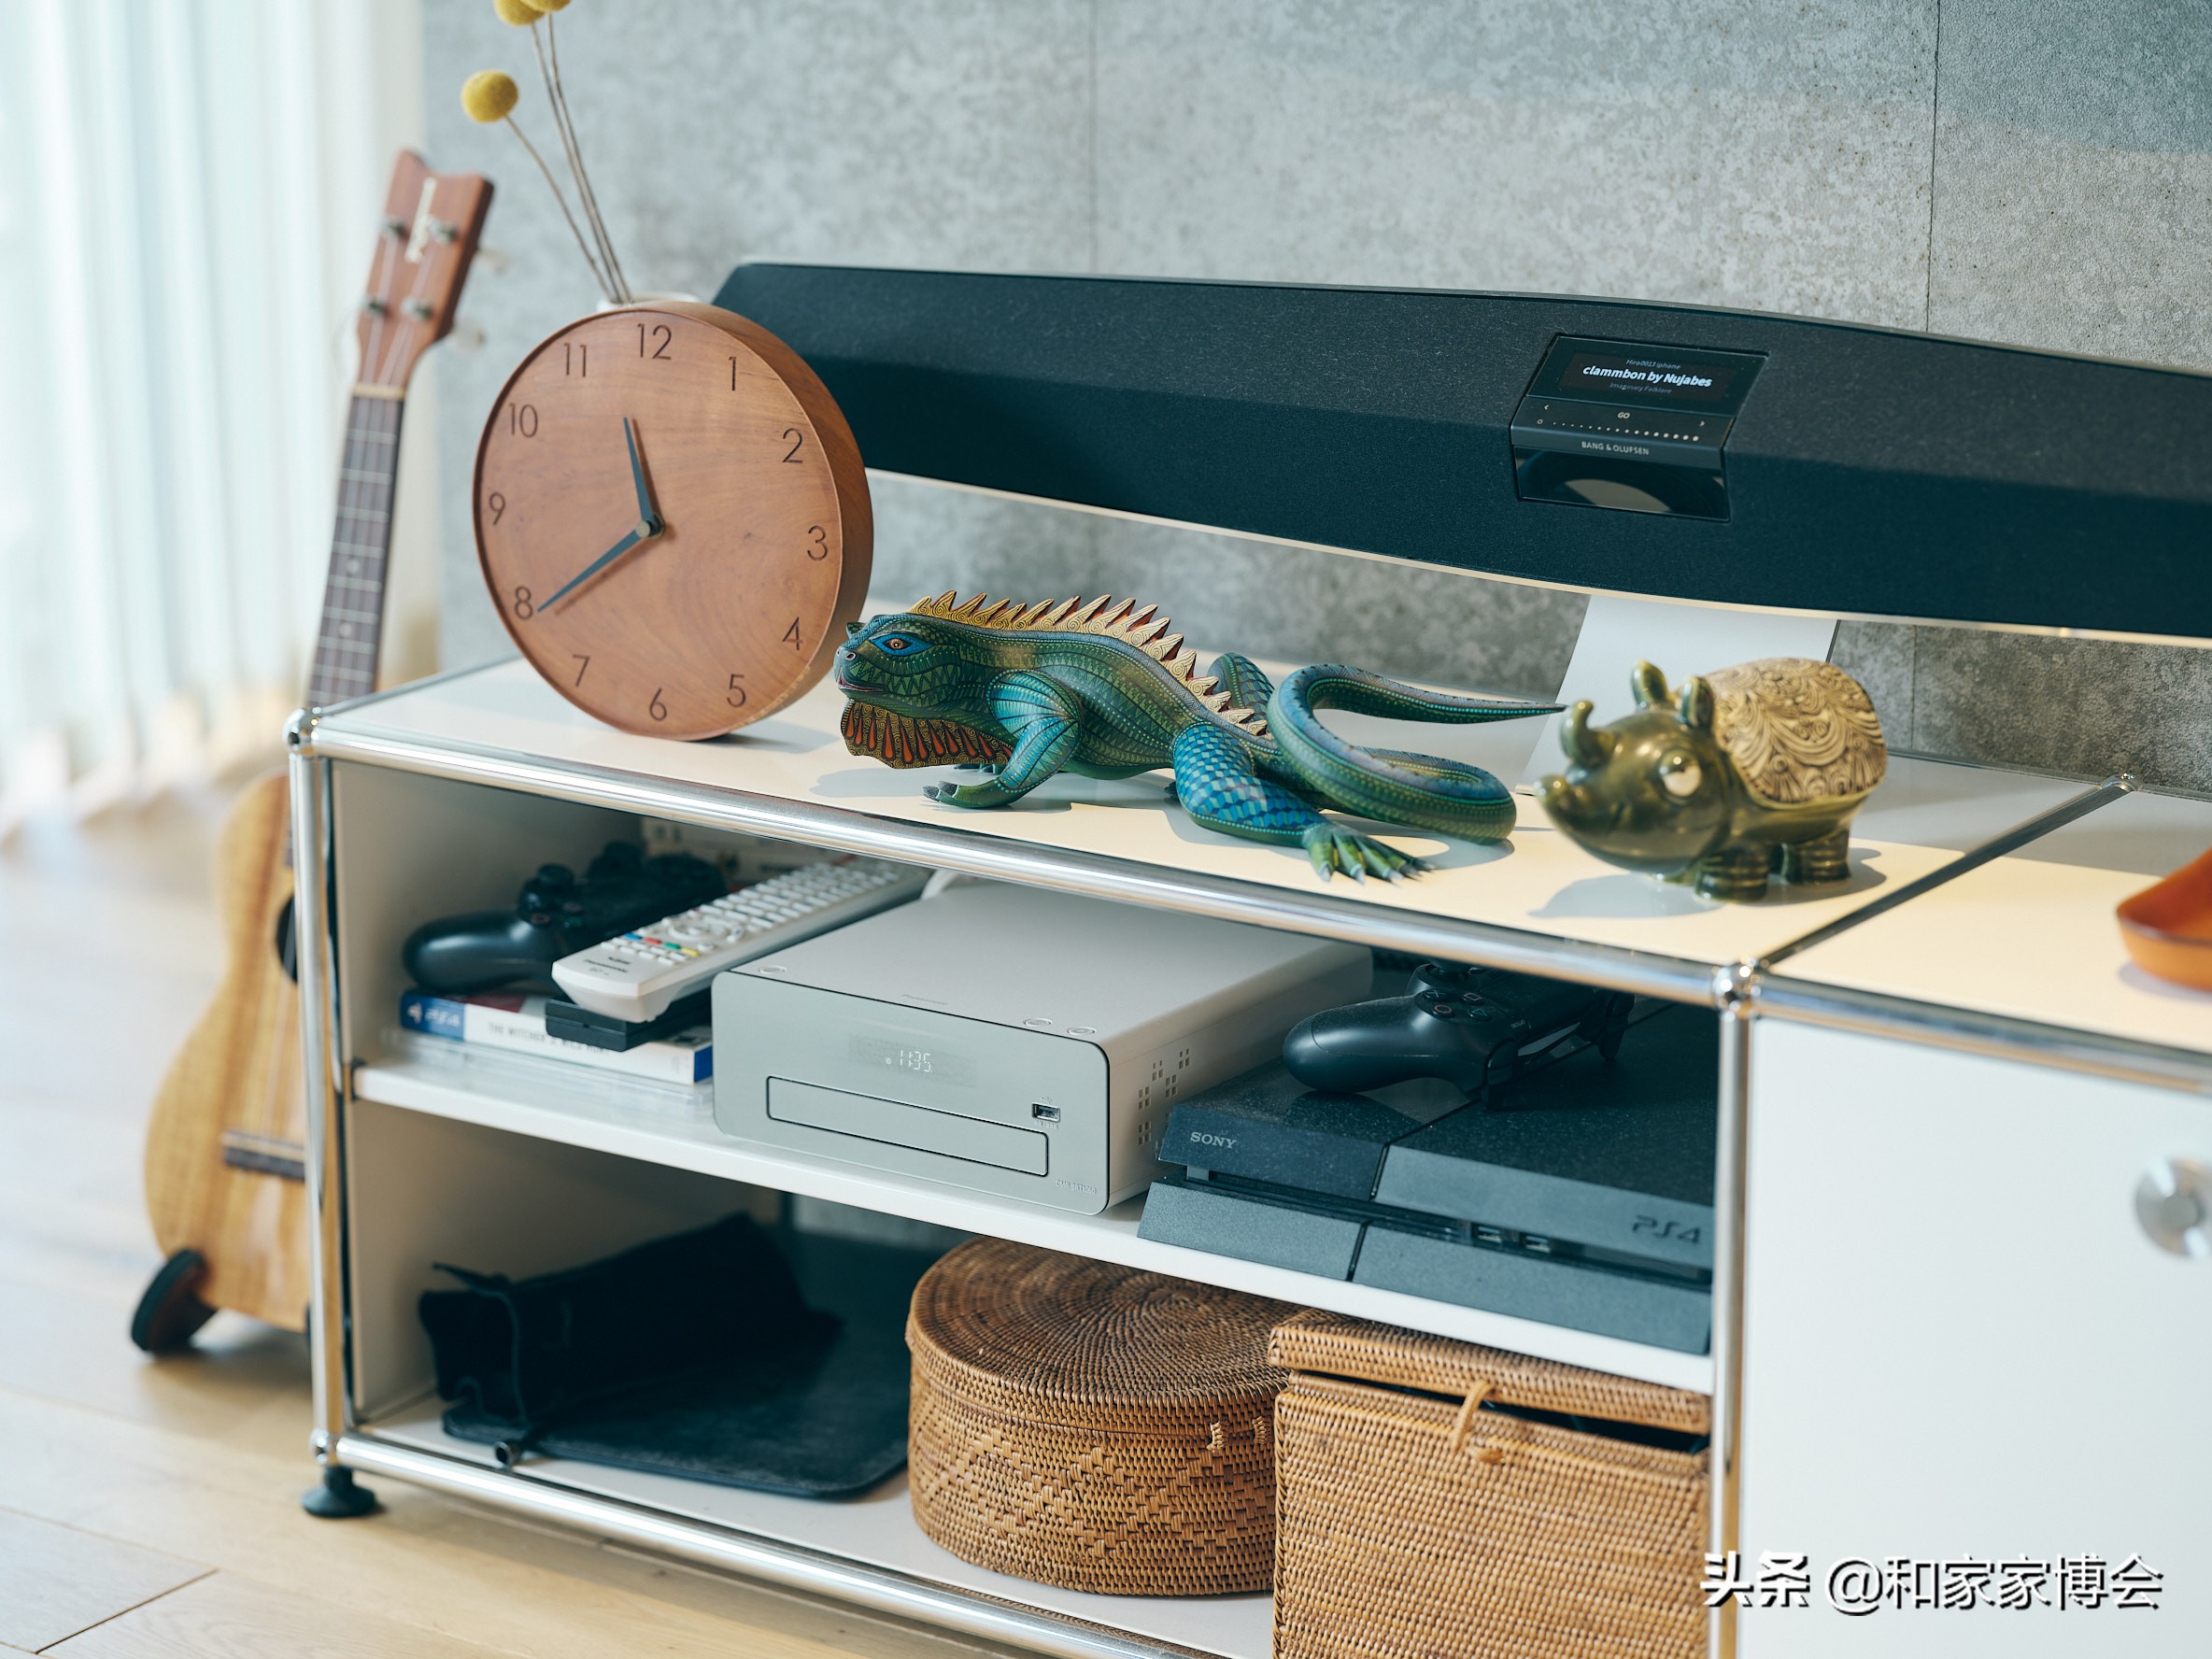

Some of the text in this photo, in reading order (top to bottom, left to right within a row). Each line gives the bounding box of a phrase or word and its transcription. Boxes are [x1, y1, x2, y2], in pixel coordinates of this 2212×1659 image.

[637, 323, 672, 361] 12
[563, 342, 588, 378] 11
[728, 356, 737, 391] 1
[1582, 365, 1713, 388] clammbon by Nujabes
[508, 403, 539, 437] 10
[1617, 411, 1631, 419] GO
[782, 428, 804, 464] 2
[1581, 441, 1605, 451] BANG
[1613, 446, 1650, 456] OLUFSEN
[489, 492, 506, 526] 9
[806, 525, 829, 561] 3
[514, 587, 533, 620] 8
[782, 617, 804, 651] 4
[573, 655, 591, 688] 7
[648, 688, 668, 721] 6
[727, 674, 747, 708] 5
[1190, 1131, 1238, 1149] SONY
[1632, 1214, 1701, 1244] PS4
